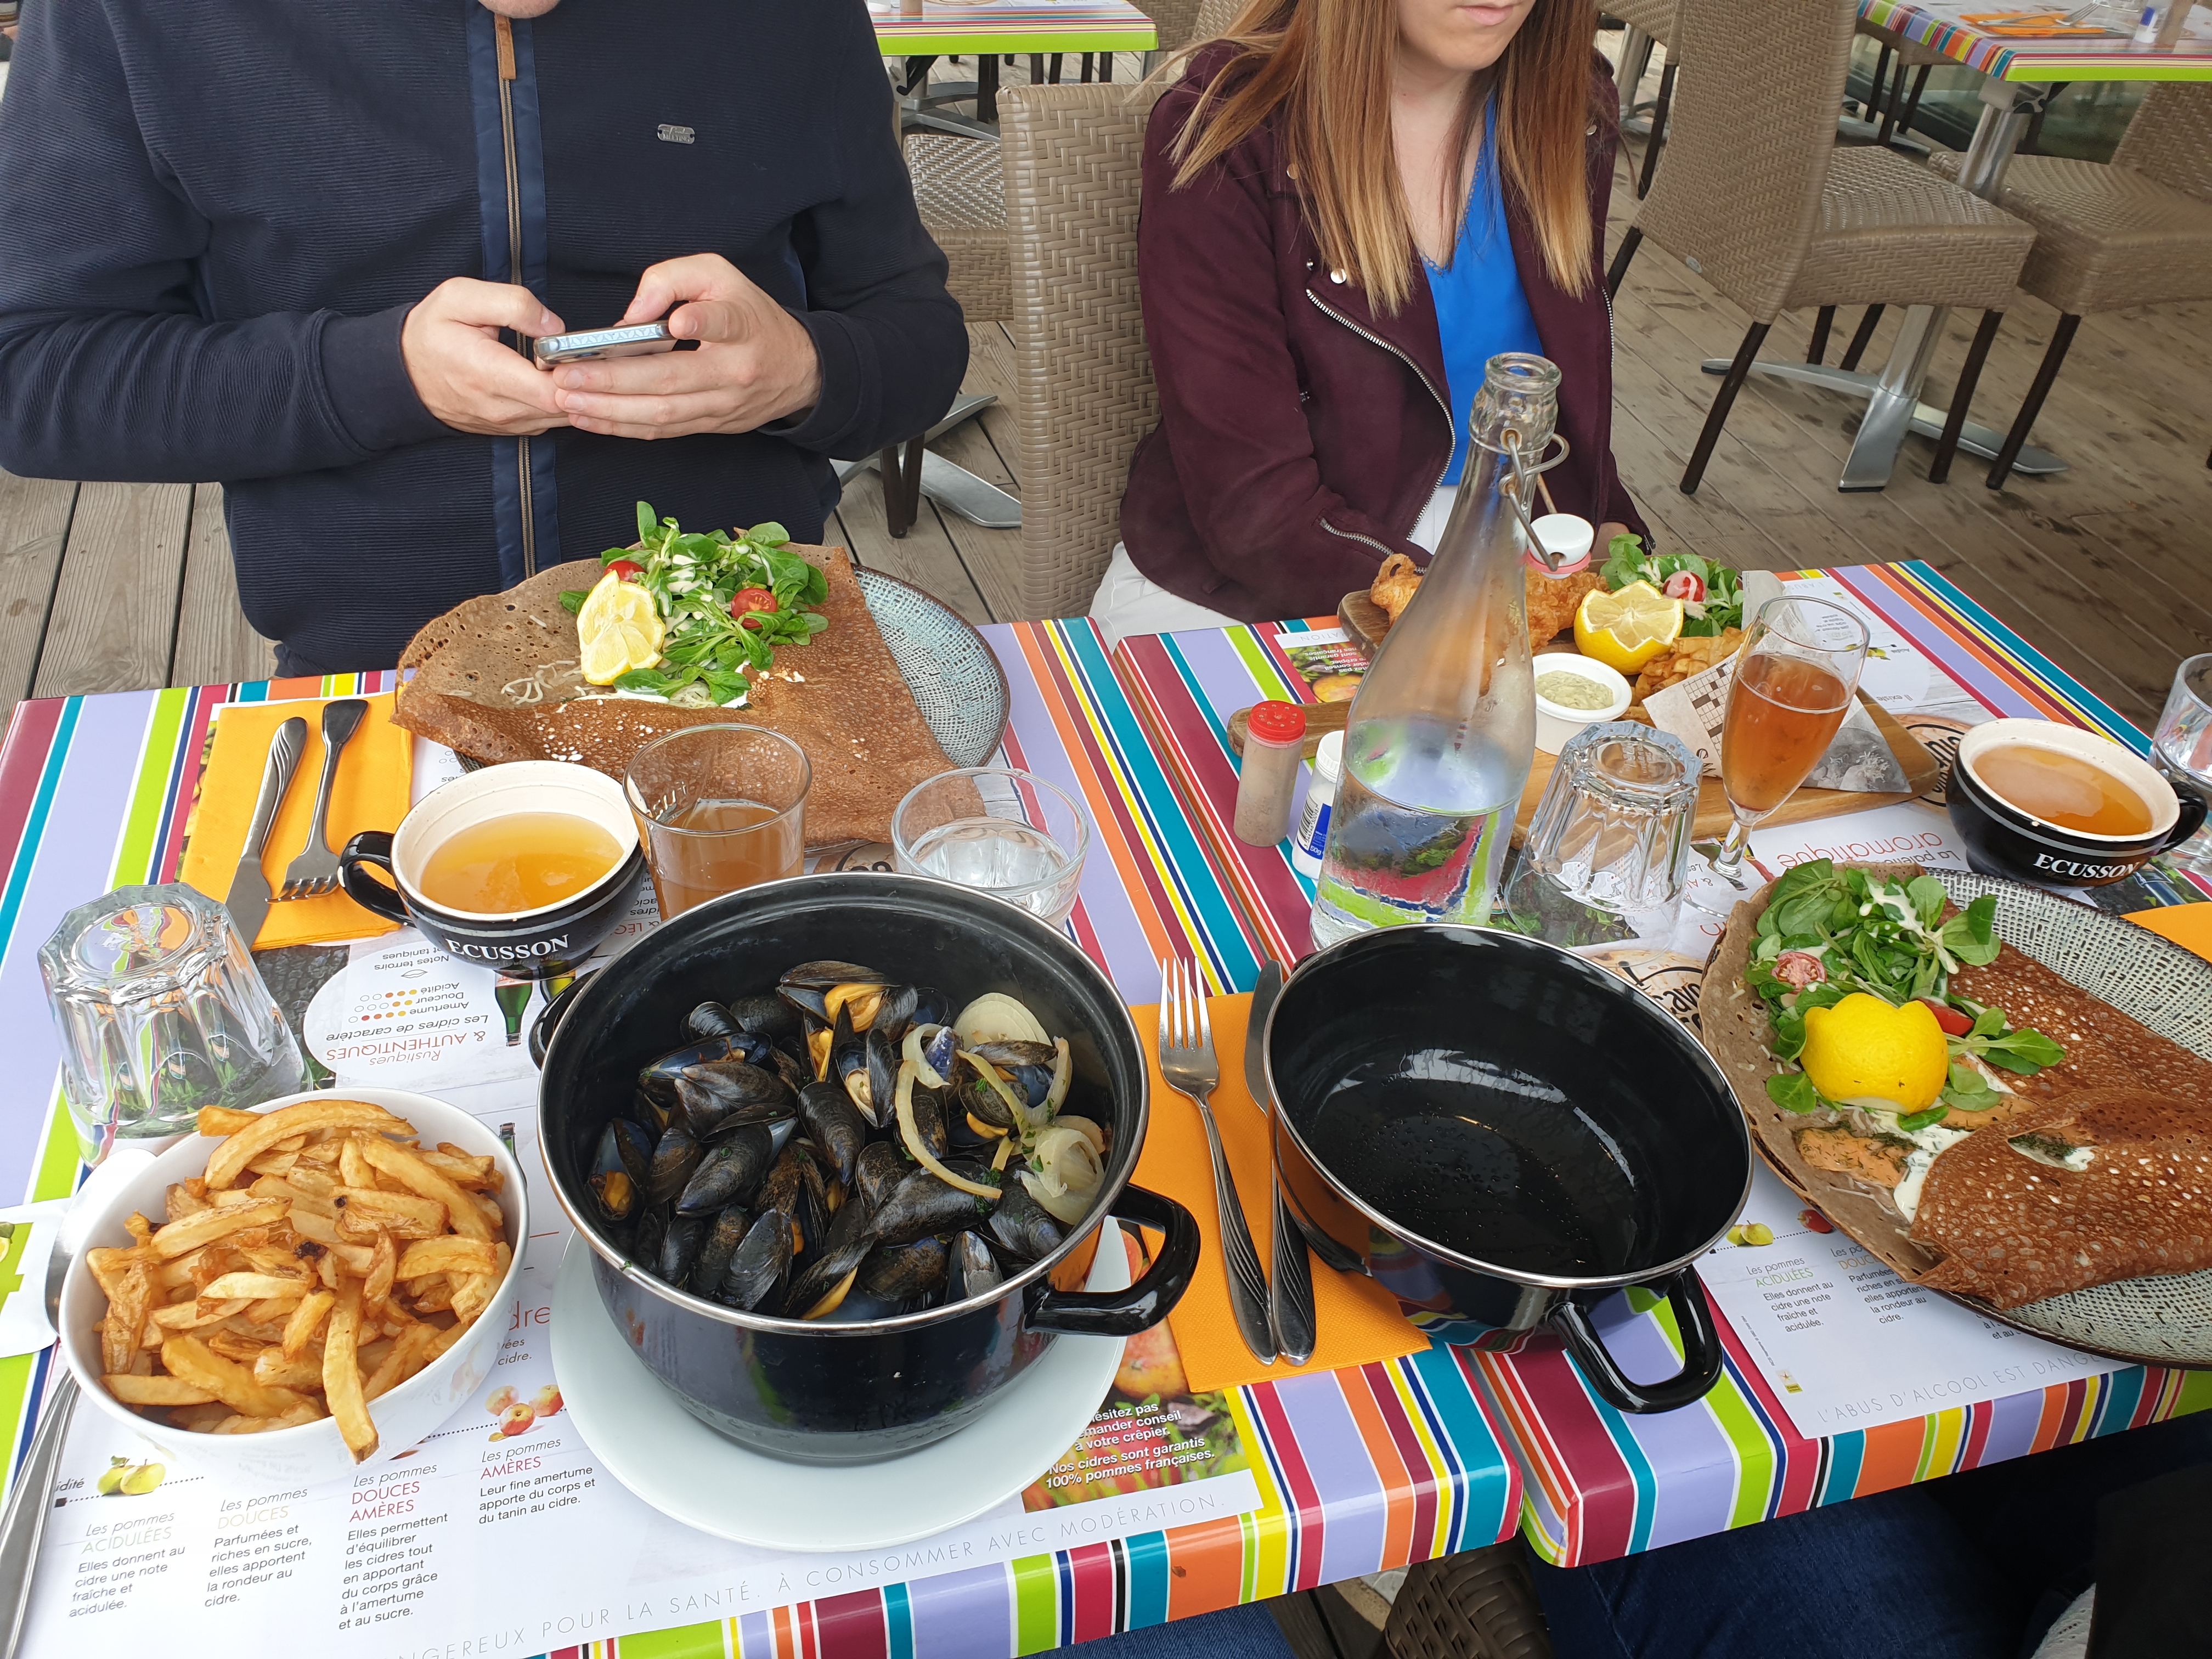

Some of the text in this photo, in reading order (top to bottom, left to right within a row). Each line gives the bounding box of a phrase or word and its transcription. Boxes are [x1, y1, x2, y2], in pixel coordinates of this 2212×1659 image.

[1876, 695, 1903, 703] existe
[1937, 850, 1961, 861] La
[2033, 853, 2140, 878] ECUSSON
[630, 907, 659, 916] idres
[382, 947, 430, 961] taniques
[445, 934, 569, 960] ECUSSON
[374, 955, 449, 972] Notes terroirs
[415, 991, 464, 1006] Douceur
[420, 981, 460, 995] Acidité
[409, 1001, 470, 1015] Amertume
[326, 1014, 489, 1042] Les cidres de caractère
[326, 1030, 486, 1061] & AUTHENTIQUES
[369, 1049, 441, 1066] Rustiques
[1830, 1248, 1847, 1257] Les
[1838, 1255, 1881, 1270] DOUC
[1746, 1257, 1805, 1276] Les pommes
[1756, 1266, 1814, 1288] ACIDULÉES
[1848, 1267, 1894, 1283] Parfumées
[1763, 1280, 1833, 1302] Elles donnent au
[1856, 1281, 1883, 1293] riches
[1884, 1279, 1895, 1288] en
[1864, 1292, 1884, 1304] elles
[1771, 1293, 1831, 1312] cidre une note
[1777, 1307, 1819, 1322] fraîche et
[1870, 1295, 1927, 1314] la rondeur au
[509, 1300, 551, 1331] dre
[1785, 1318, 1824, 1333] acidulée.
[1879, 1313, 1904, 1325] cidre.
[2004, 1329, 2015, 1338] au
[498, 1351, 532, 1366] cidre.
[1816, 1365, 2027, 1424] L'ABUS D'ALCOOL EST
[1079, 1409, 1182, 1438] mander conseil
[1092, 1403, 1159, 1423] ésitez pas
[482, 1438, 561, 1463] Les pommes
[1075, 1426, 1171, 1452] à votre crêpier.
[481, 1455, 541, 1480] AMÈRES
[1049, 1437, 1205, 1475] Nos cidres sont garantis
[353, 1464, 438, 1488] Les pommes
[1046, 1449, 1216, 1489] 100% pommes françaises.
[55, 1477, 84, 1492] idité
[352, 1481, 421, 1505] DOUCES
[480, 1466, 593, 1497] Leur fine amertume
[220, 1488, 308, 1512] Les pommes
[479, 1477, 596, 1511] apporte du corps et
[218, 1505, 289, 1530] DOUCES
[349, 1499, 415, 1523] AMÈRES
[479, 1496, 582, 1524] du tanin au cidre.
[86, 1513, 175, 1537] Les pommes
[214, 1524, 300, 1548] Parfumées et
[348, 1513, 449, 1541] Elles permettent
[81, 1526, 172, 1555] ACIDULÉES
[211, 1537, 312, 1563] riches en sucre,
[346, 1534, 417, 1555] d'équilibrer
[78, 1547, 185, 1573] Elles donnent au
[209, 1550, 306, 1577] elles apportent
[345, 1543, 433, 1570] les cidres tout
[75, 1564, 168, 1588] cidre une note
[207, 1568, 292, 1592] la rondeur au
[343, 1559, 425, 1585] en apportant
[399, 1493, 1225, 1659] GEREUX POUR LA SANTÉ. À CONSOMMER AVEC MODÉRATION.
[71, 1583, 133, 1602] fraîche et
[342, 1571, 438, 1600] du corps grâce
[69, 1599, 127, 1617] acidulée.
[205, 1593, 240, 1607] cidre.
[340, 1589, 424, 1615] à l'amertume
[338, 1606, 414, 1630] et au sucre.
